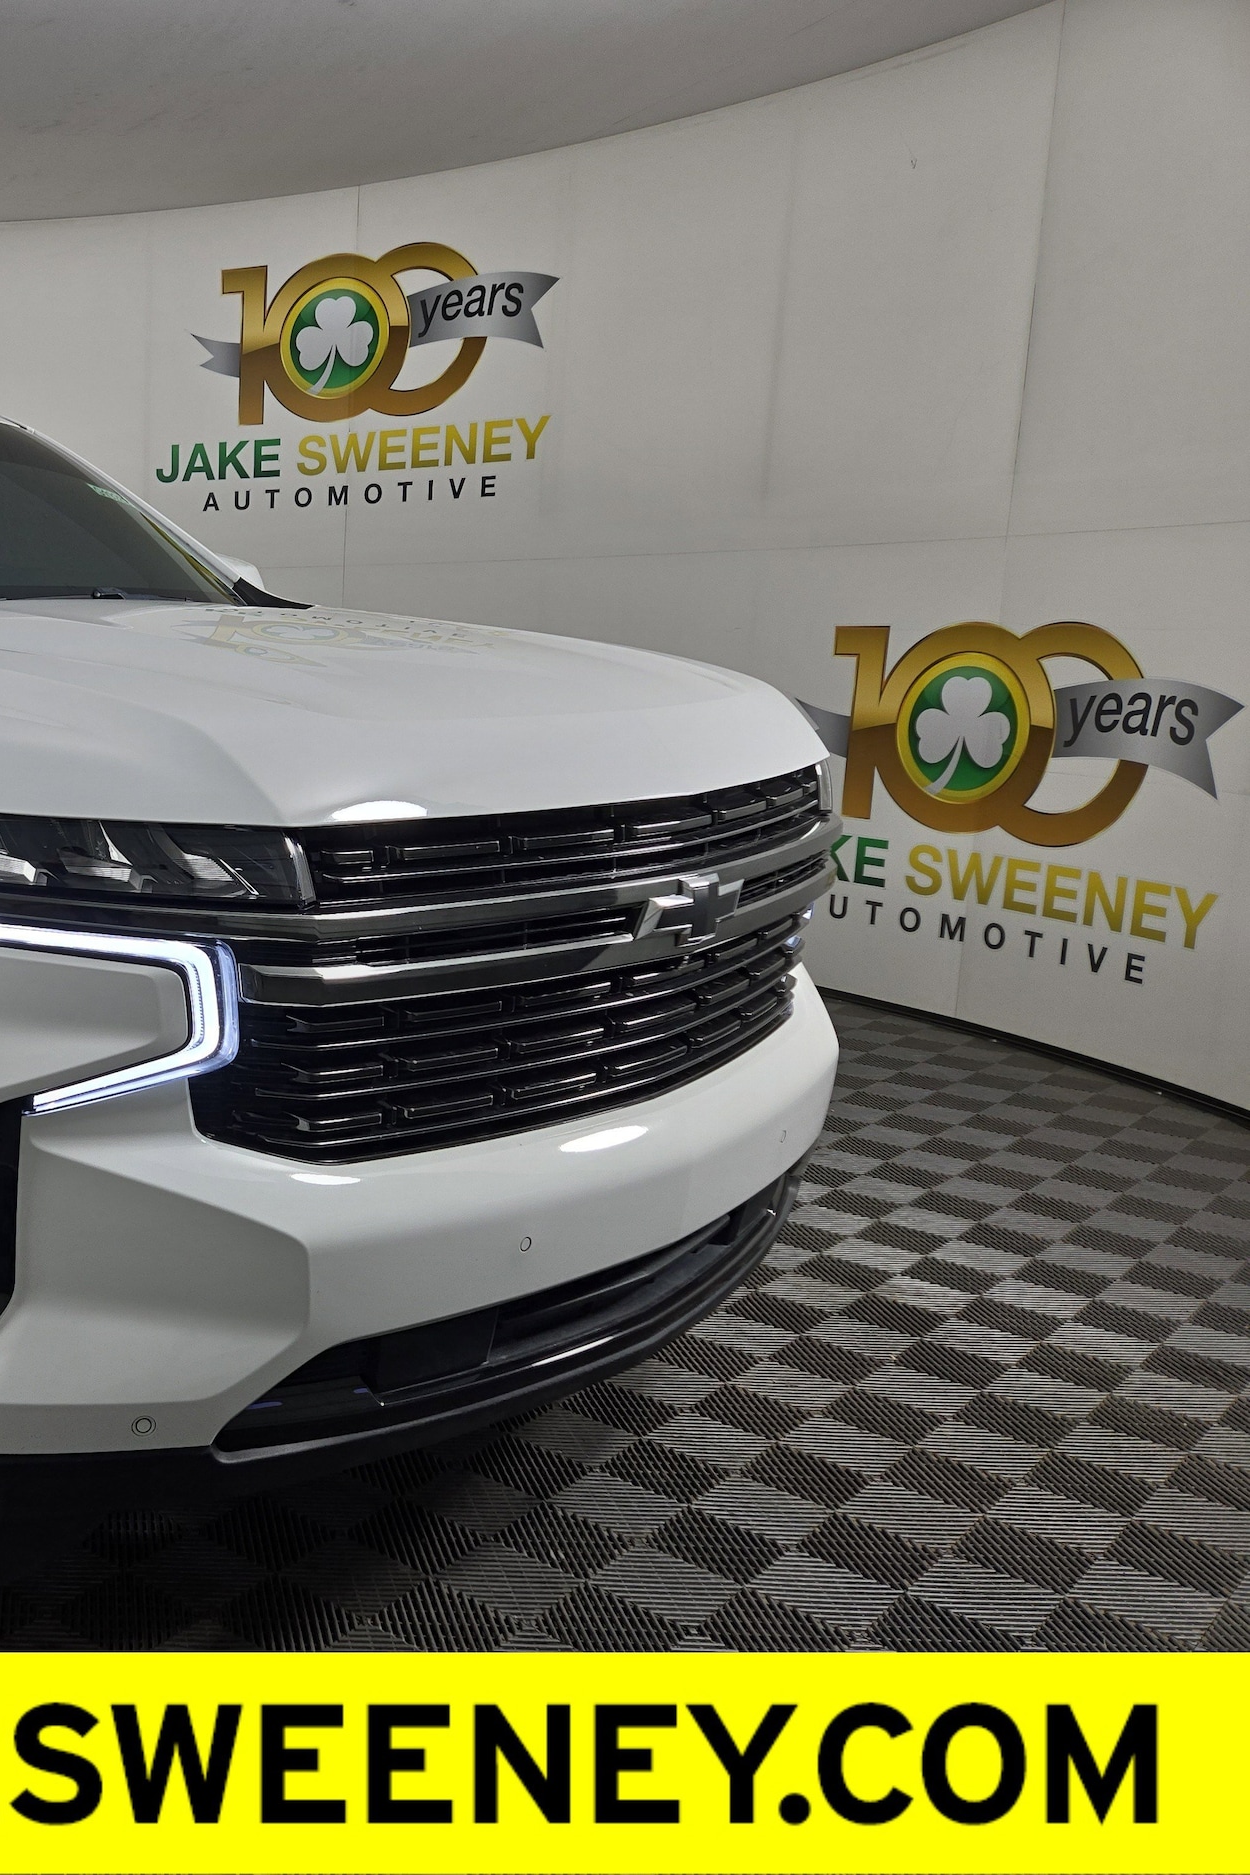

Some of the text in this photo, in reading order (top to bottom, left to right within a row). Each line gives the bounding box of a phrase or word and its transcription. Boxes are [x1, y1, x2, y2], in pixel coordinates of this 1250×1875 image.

[417, 280, 524, 337] years
[156, 415, 551, 483] JAKE SWEENEY
[203, 475, 497, 512] AUTOMOTIVE
[1063, 691, 1199, 746] years
[905, 844, 1218, 950] SWEENEY
[829, 894, 1147, 984] UTOMOTIVE
